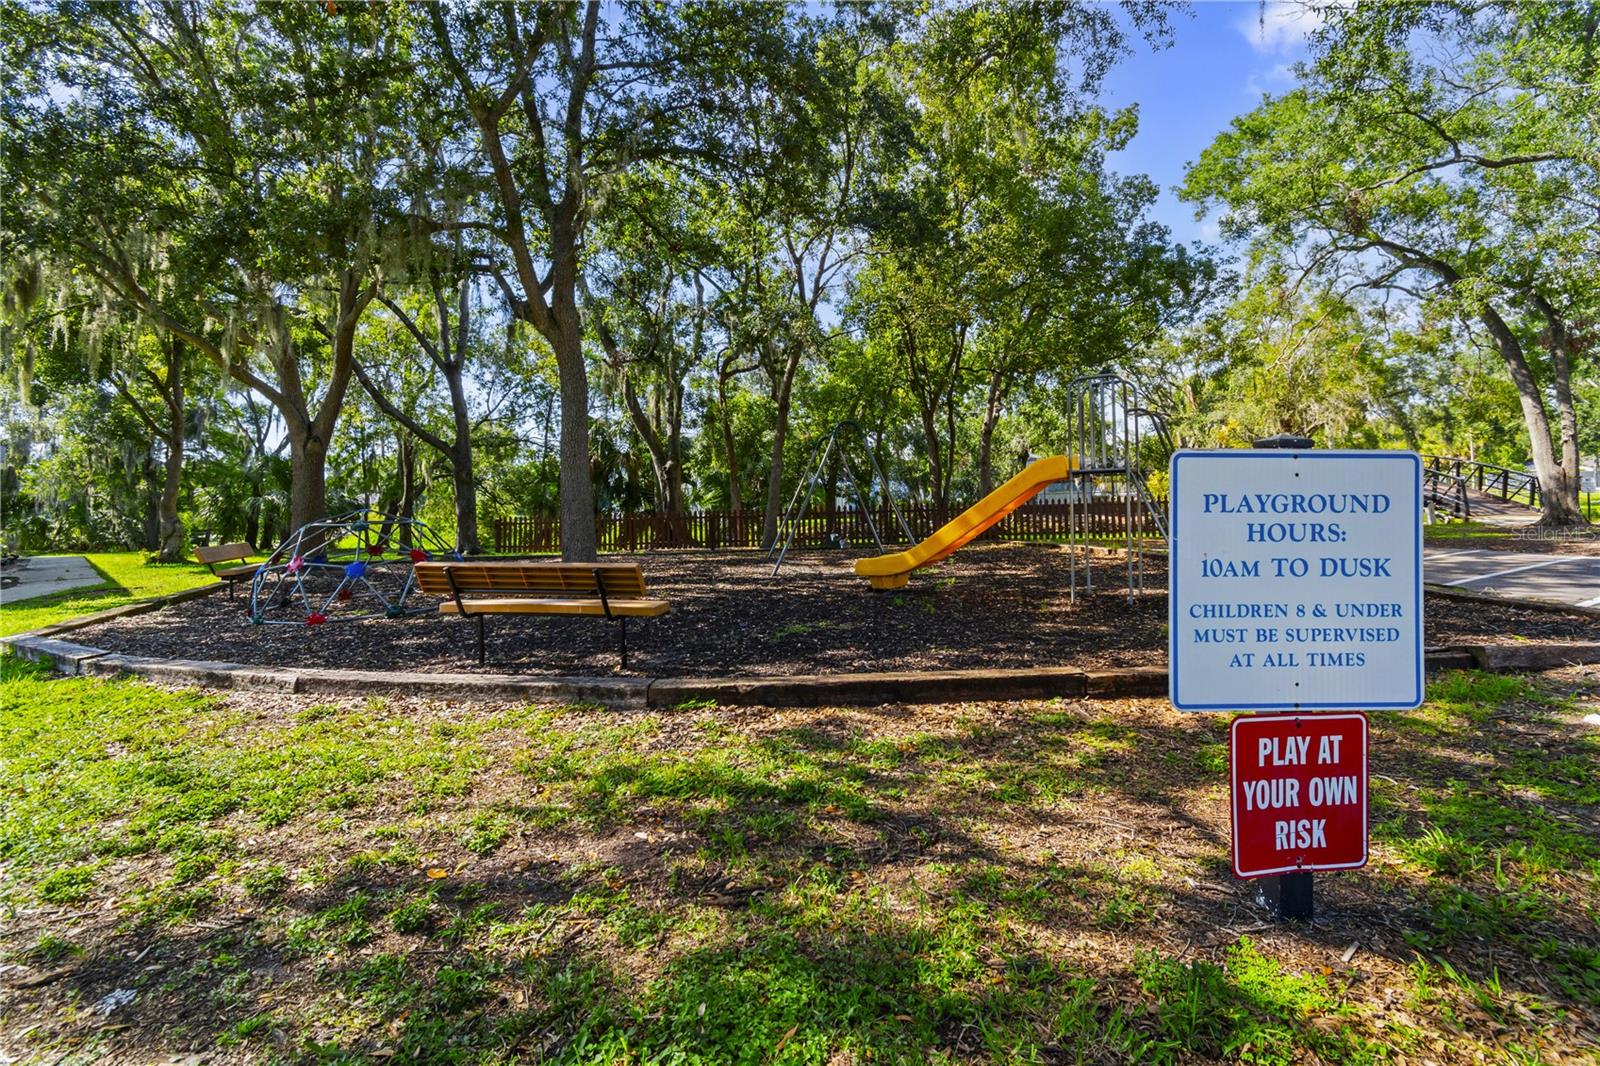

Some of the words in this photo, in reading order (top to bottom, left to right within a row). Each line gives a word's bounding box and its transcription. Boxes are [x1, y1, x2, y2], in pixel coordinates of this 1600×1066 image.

[1203, 494, 1391, 514] PLAYGROUND
[1247, 522, 1347, 542] HOURS:
[1201, 558, 1260, 577] 10AM
[1271, 558, 1309, 577] TO
[1319, 557, 1391, 577] DUSK
[1189, 603, 1288, 618] CHILDREN
[1296, 603, 1306, 618] 8
[1312, 603, 1327, 618] &
[1336, 603, 1403, 618] UNDER
[1194, 628, 1248, 643] MUST
[1255, 628, 1278, 643] BE
[1285, 627, 1400, 643] SUPERVISED
[1229, 653, 1255, 667] AT
[1263, 653, 1299, 667] ALL
[1306, 652, 1366, 667] TIMES
[1258, 735, 1311, 767] PLAY
[1317, 735, 1343, 765] AT
[1243, 778, 1299, 811] YOUR
[1308, 775, 1357, 807] OWN
[1275, 818, 1327, 850] RISK
